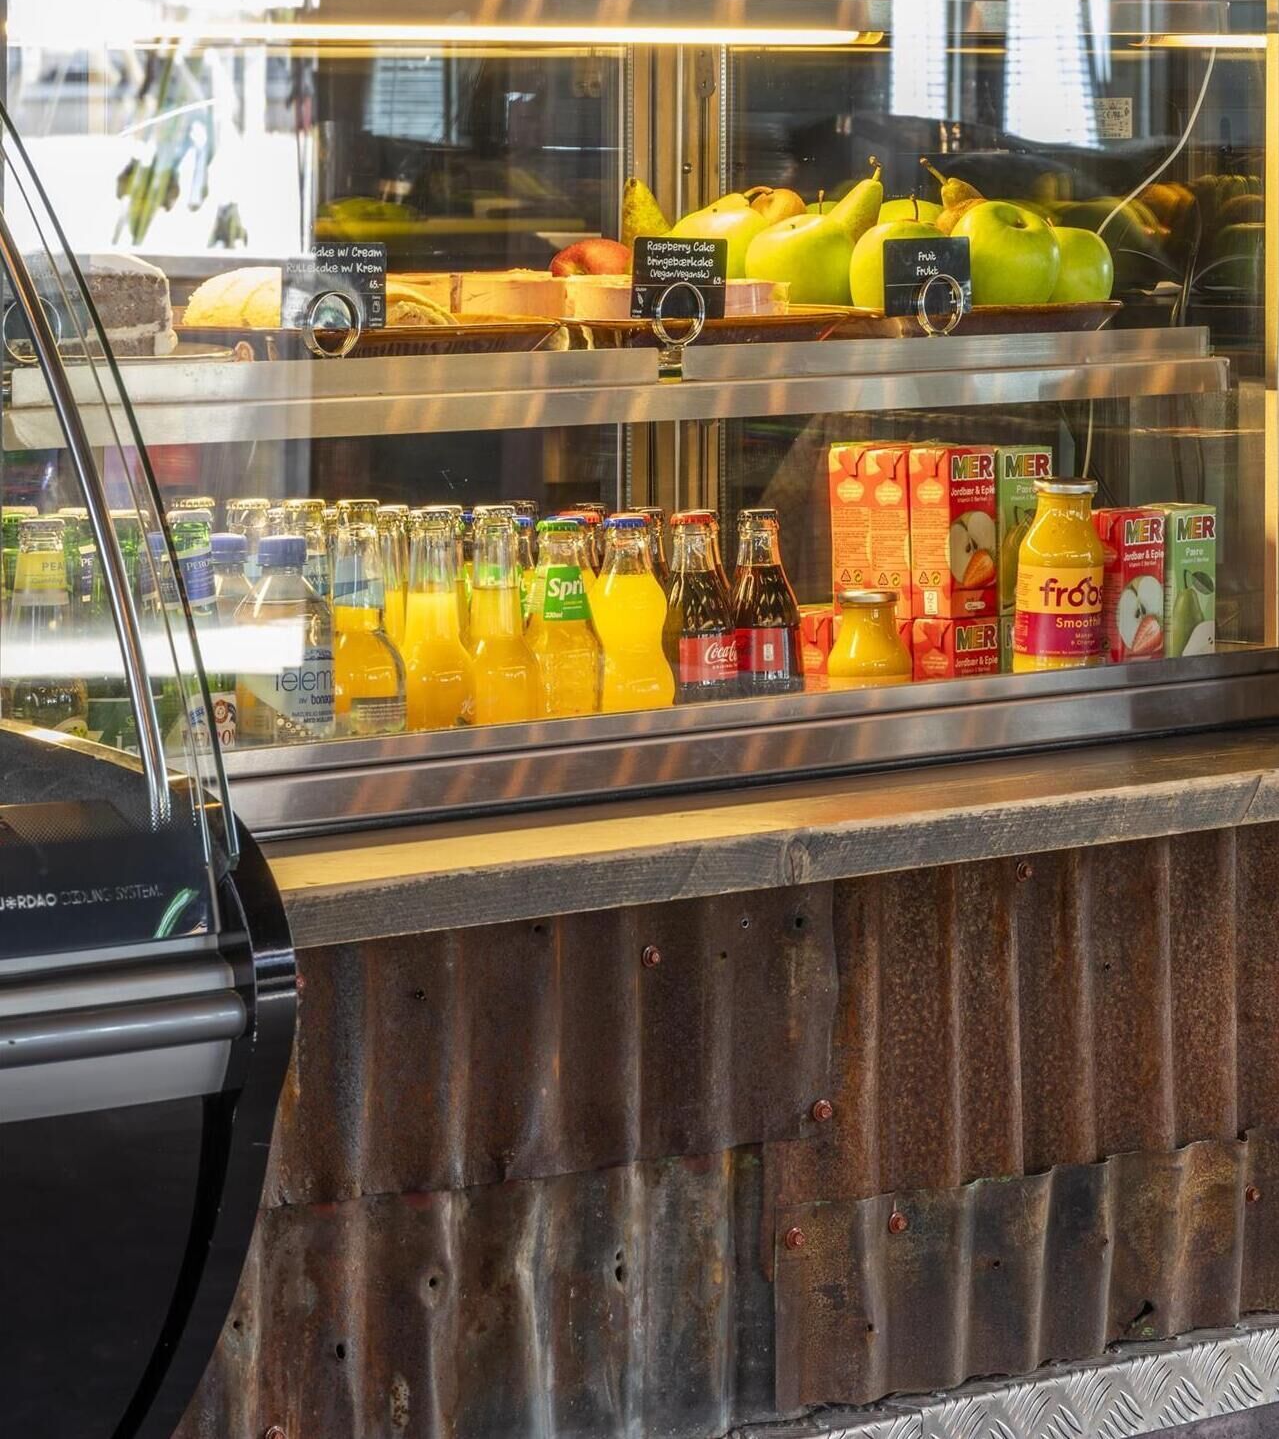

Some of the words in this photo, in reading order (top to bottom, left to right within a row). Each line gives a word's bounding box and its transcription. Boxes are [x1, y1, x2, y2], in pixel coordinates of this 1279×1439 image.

[338, 246, 349, 257] w/
[352, 247, 382, 258] Cream
[646, 240, 691, 254] Raspberry
[693, 241, 716, 252] Cake
[646, 256, 714, 269] Bringebærkake
[918, 251, 937, 262] Fruit
[287, 262, 338, 273] Rullekake
[341, 263, 353, 273] m/
[356, 262, 382, 273] Krem
[916, 266, 939, 276] Frukt
[951, 454, 994, 481] MER
[1004, 453, 1052, 479] MER
[1124, 517, 1165, 547] MER
[1176, 514, 1216, 542] MER
[955, 623, 998, 653] MER
[275, 667, 334, 692] elem
[0, 893, 57, 910] JRDAO
